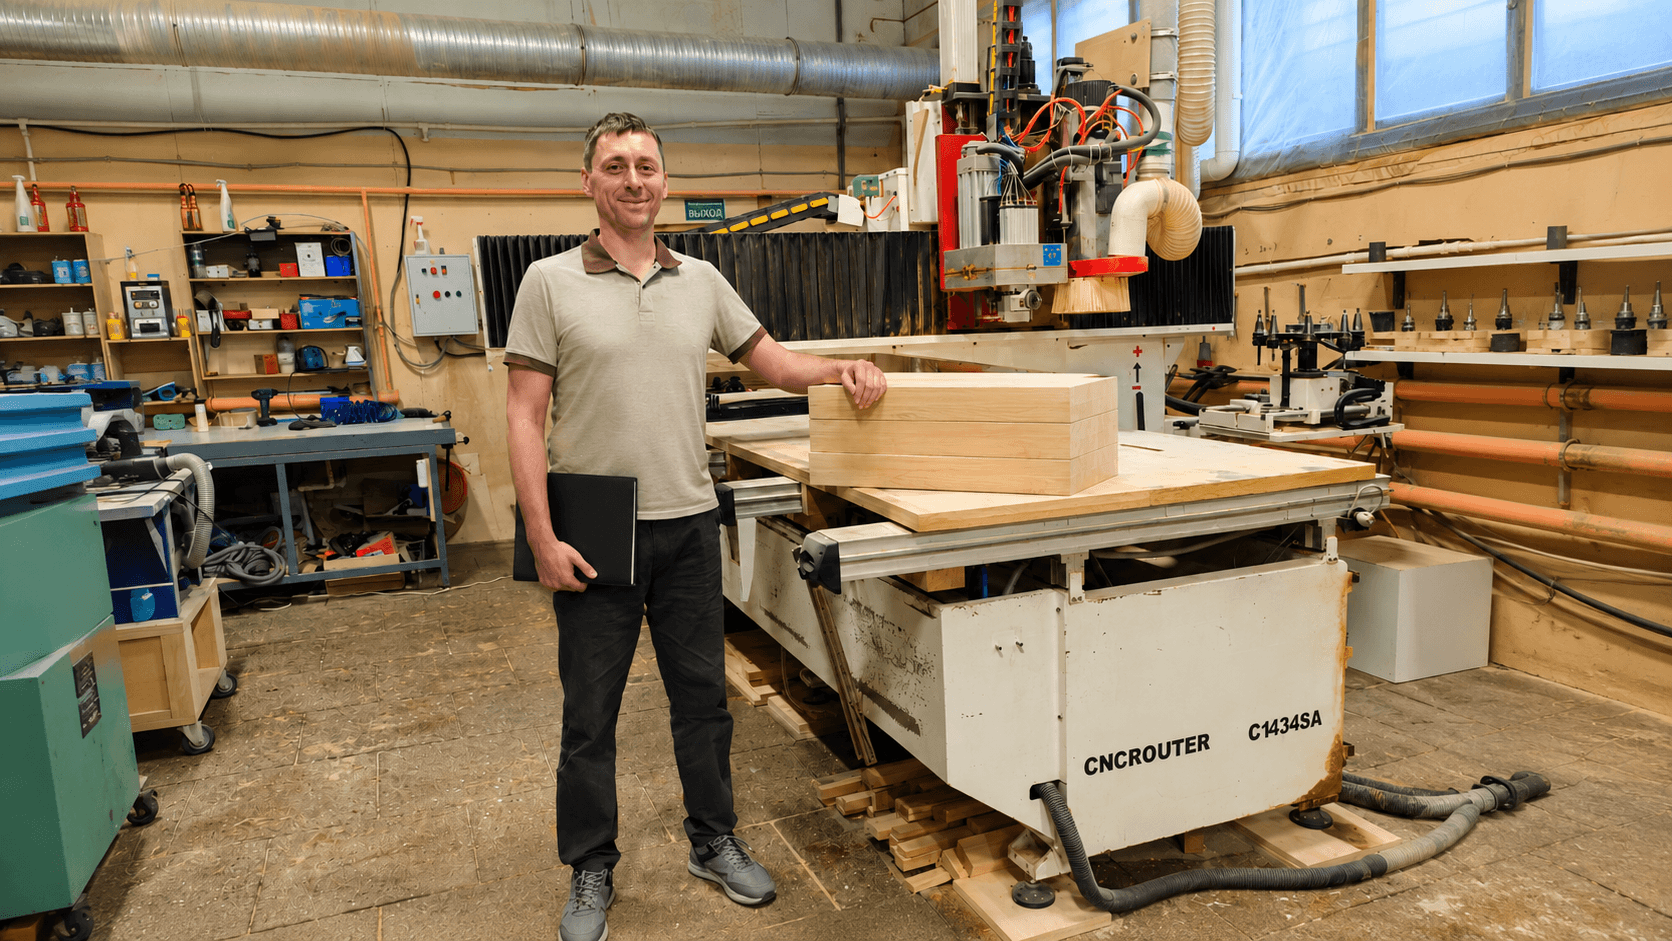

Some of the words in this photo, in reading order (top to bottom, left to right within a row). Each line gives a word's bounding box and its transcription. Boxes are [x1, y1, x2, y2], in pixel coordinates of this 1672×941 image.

[688, 209, 723, 218] ВЫХОД
[1084, 733, 1210, 776] CNCROUTER
[1248, 710, 1322, 741] C1434SA
